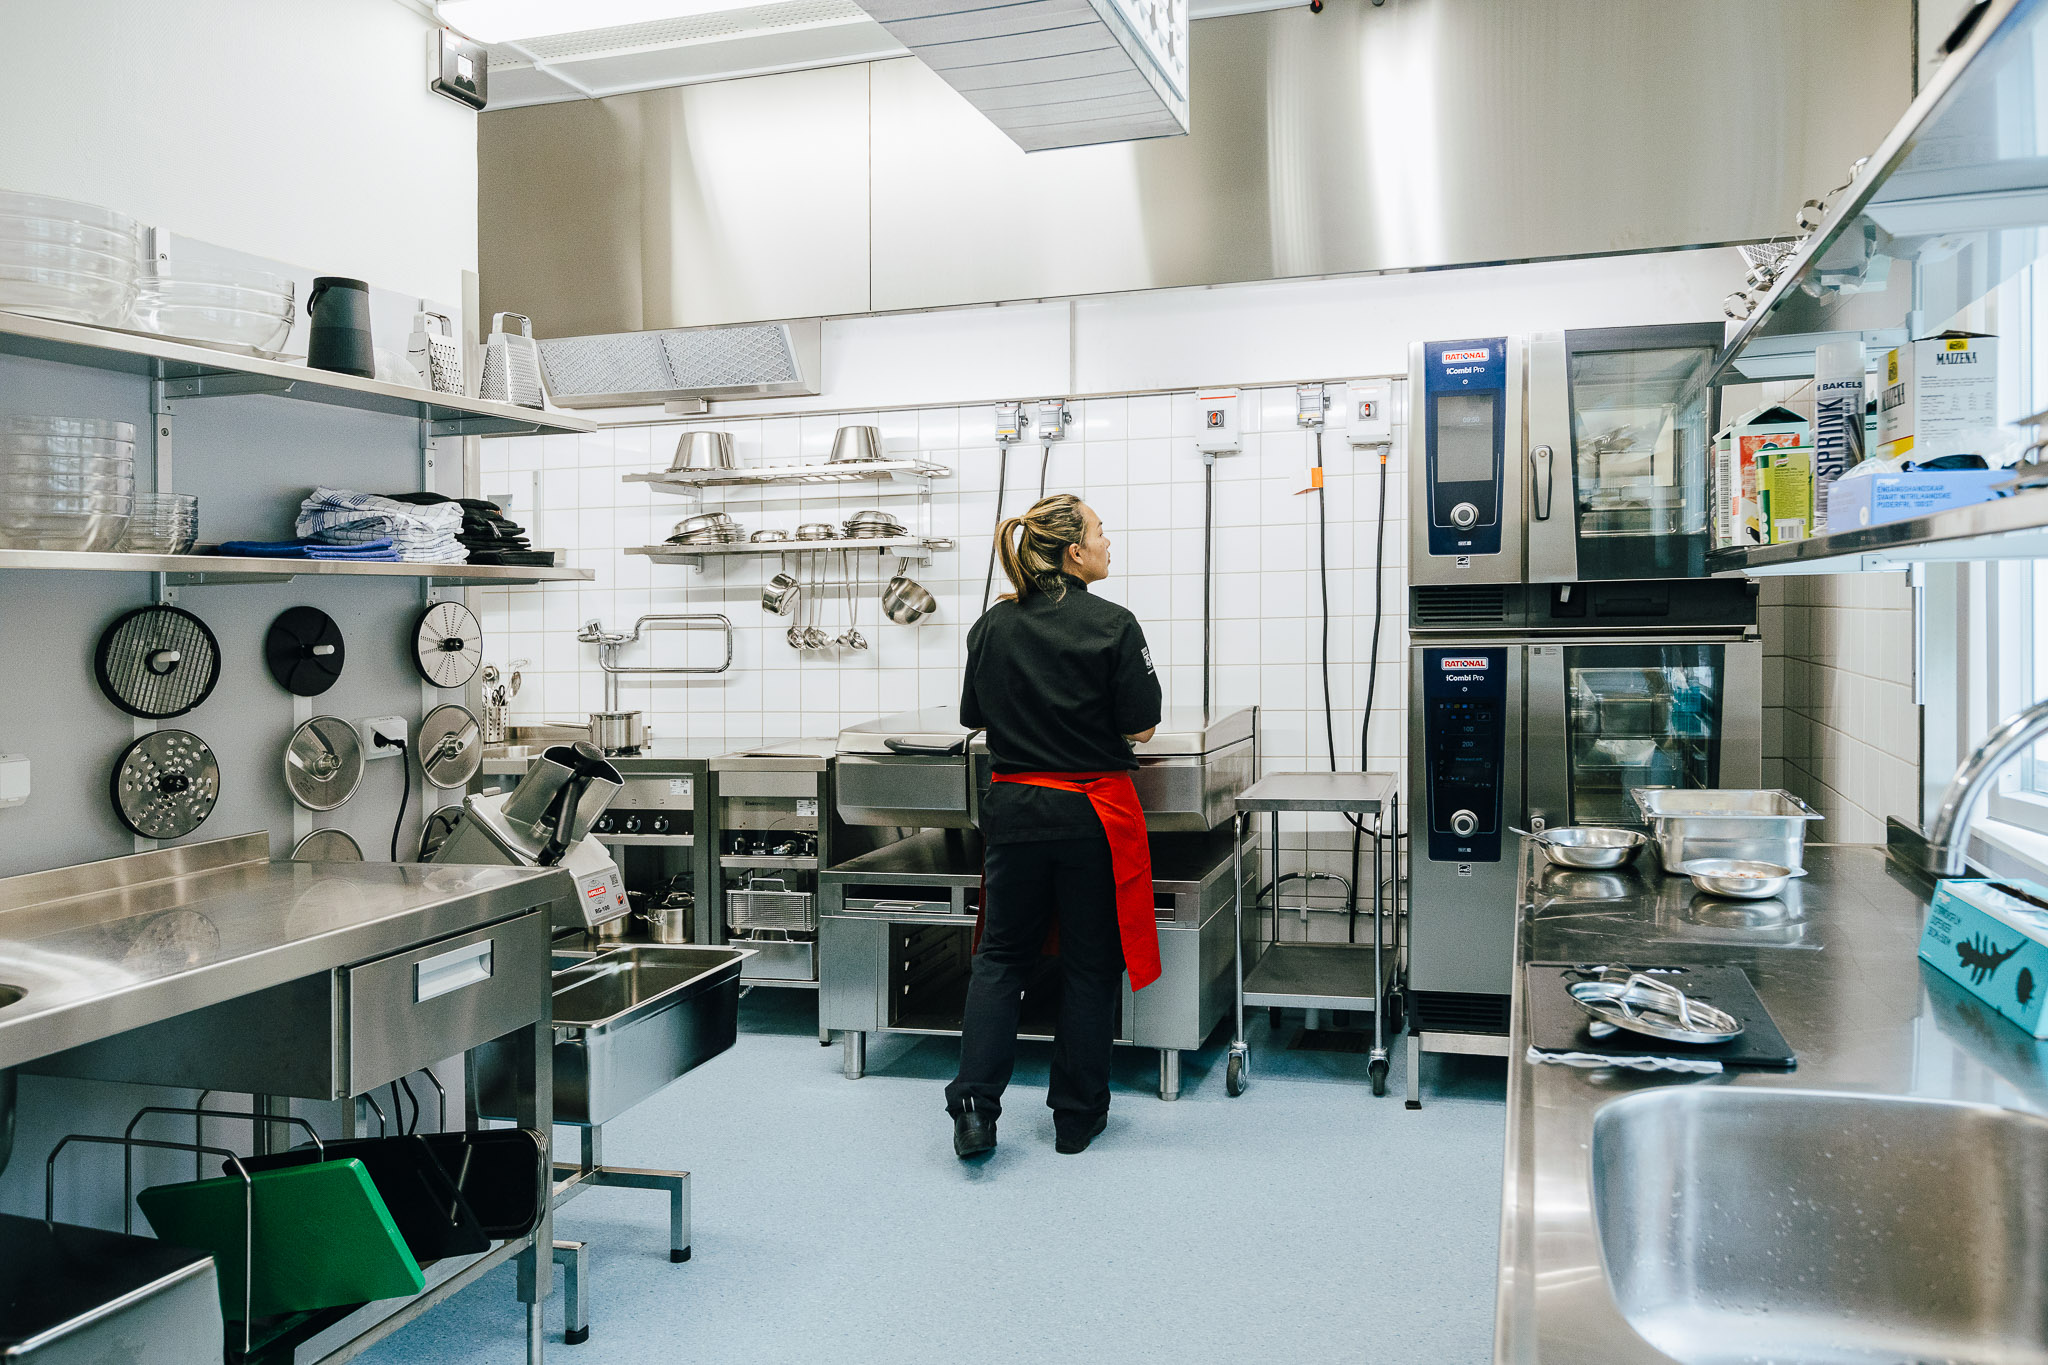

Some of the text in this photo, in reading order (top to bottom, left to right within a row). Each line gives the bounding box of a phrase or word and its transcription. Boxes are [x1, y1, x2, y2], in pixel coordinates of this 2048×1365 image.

[1445, 352, 1486, 361] RATIONAL
[1936, 352, 1977, 365] MAIZENA
[1446, 367, 1472, 375] iCombi
[1822, 381, 1863, 391] BAKELS
[1445, 660, 1486, 668] RATIONAL
[1445, 674, 1471, 682] iCombi
